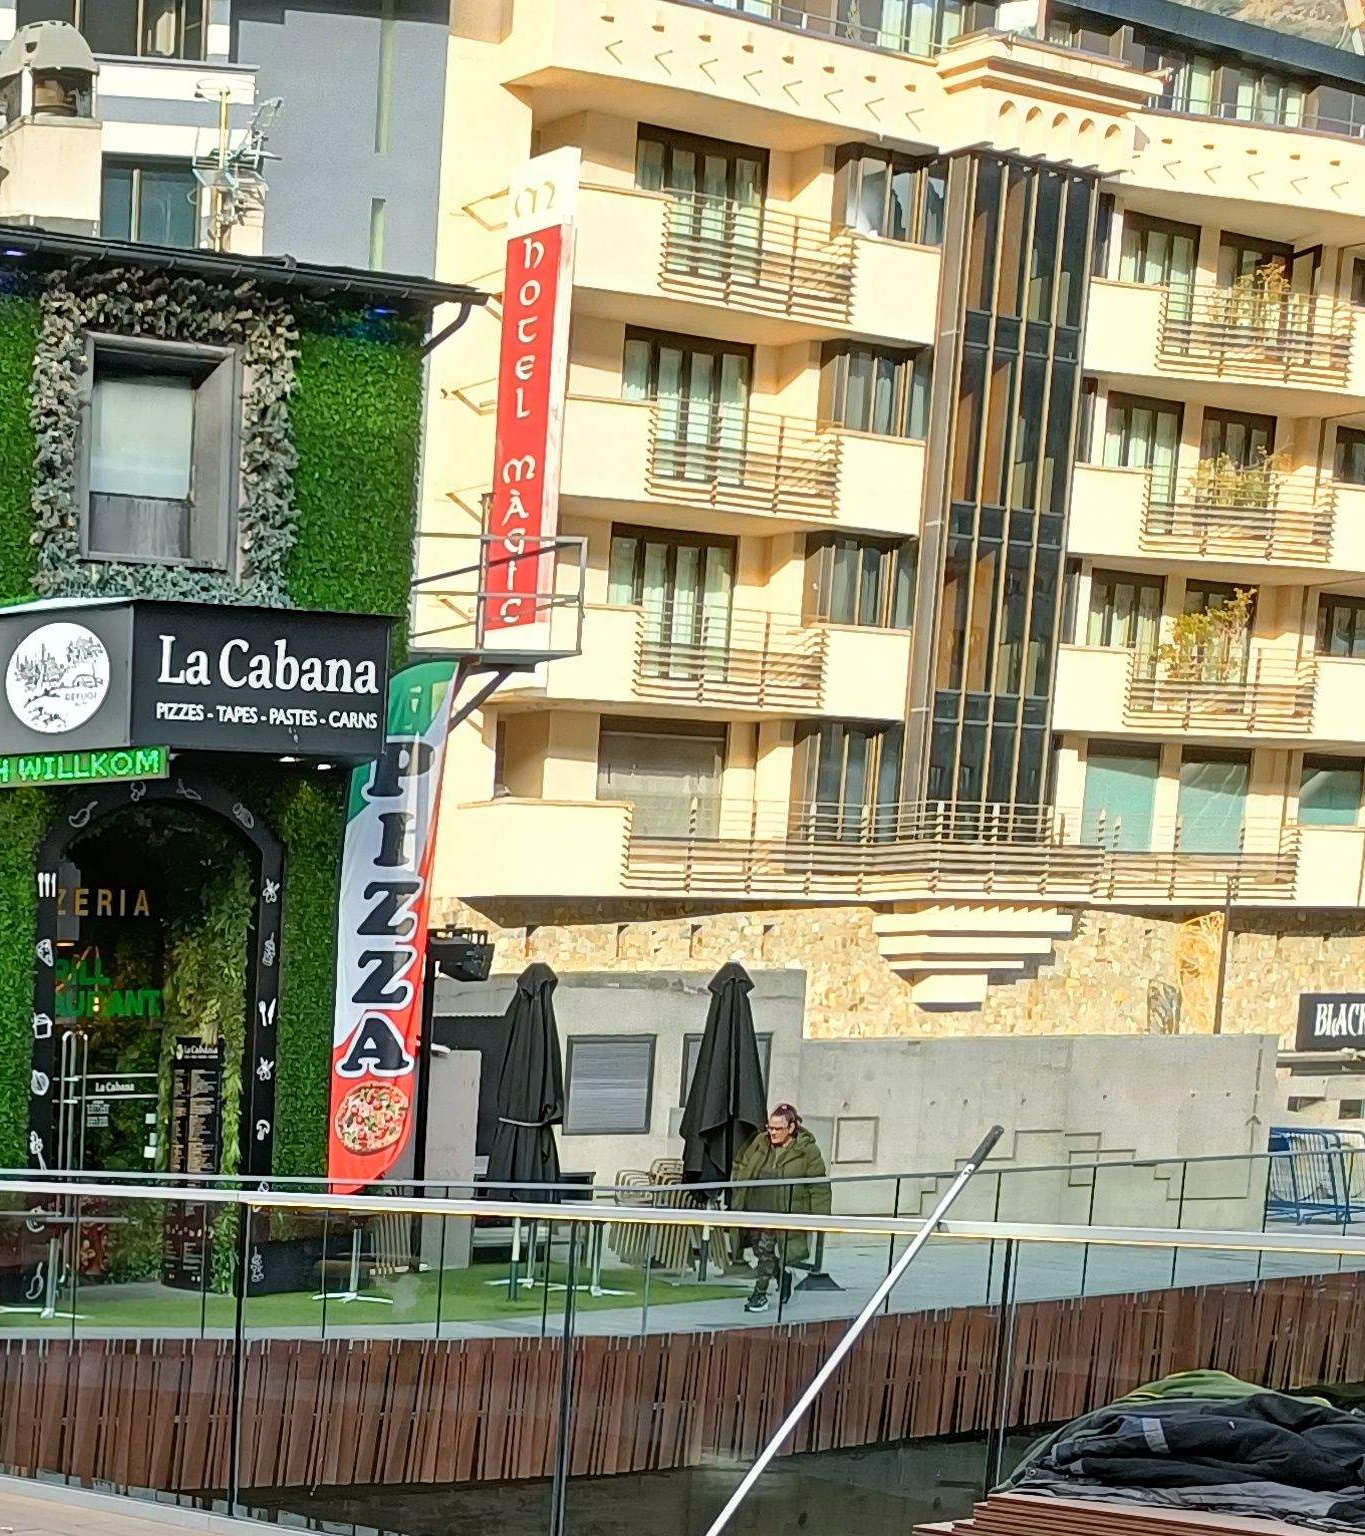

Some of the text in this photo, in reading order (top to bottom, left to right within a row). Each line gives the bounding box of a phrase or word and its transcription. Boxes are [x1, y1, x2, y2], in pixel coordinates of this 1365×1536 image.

[157, 634, 380, 695] La Cabana
[156, 701, 205, 721] PIZZES
[216, 704, 259, 725] TAPES
[269, 707, 318, 727] PASTES
[328, 710, 378, 730] CARNS
[18, 750, 160, 781] WILLKOM
[337, 740, 435, 1075] PIZZA
